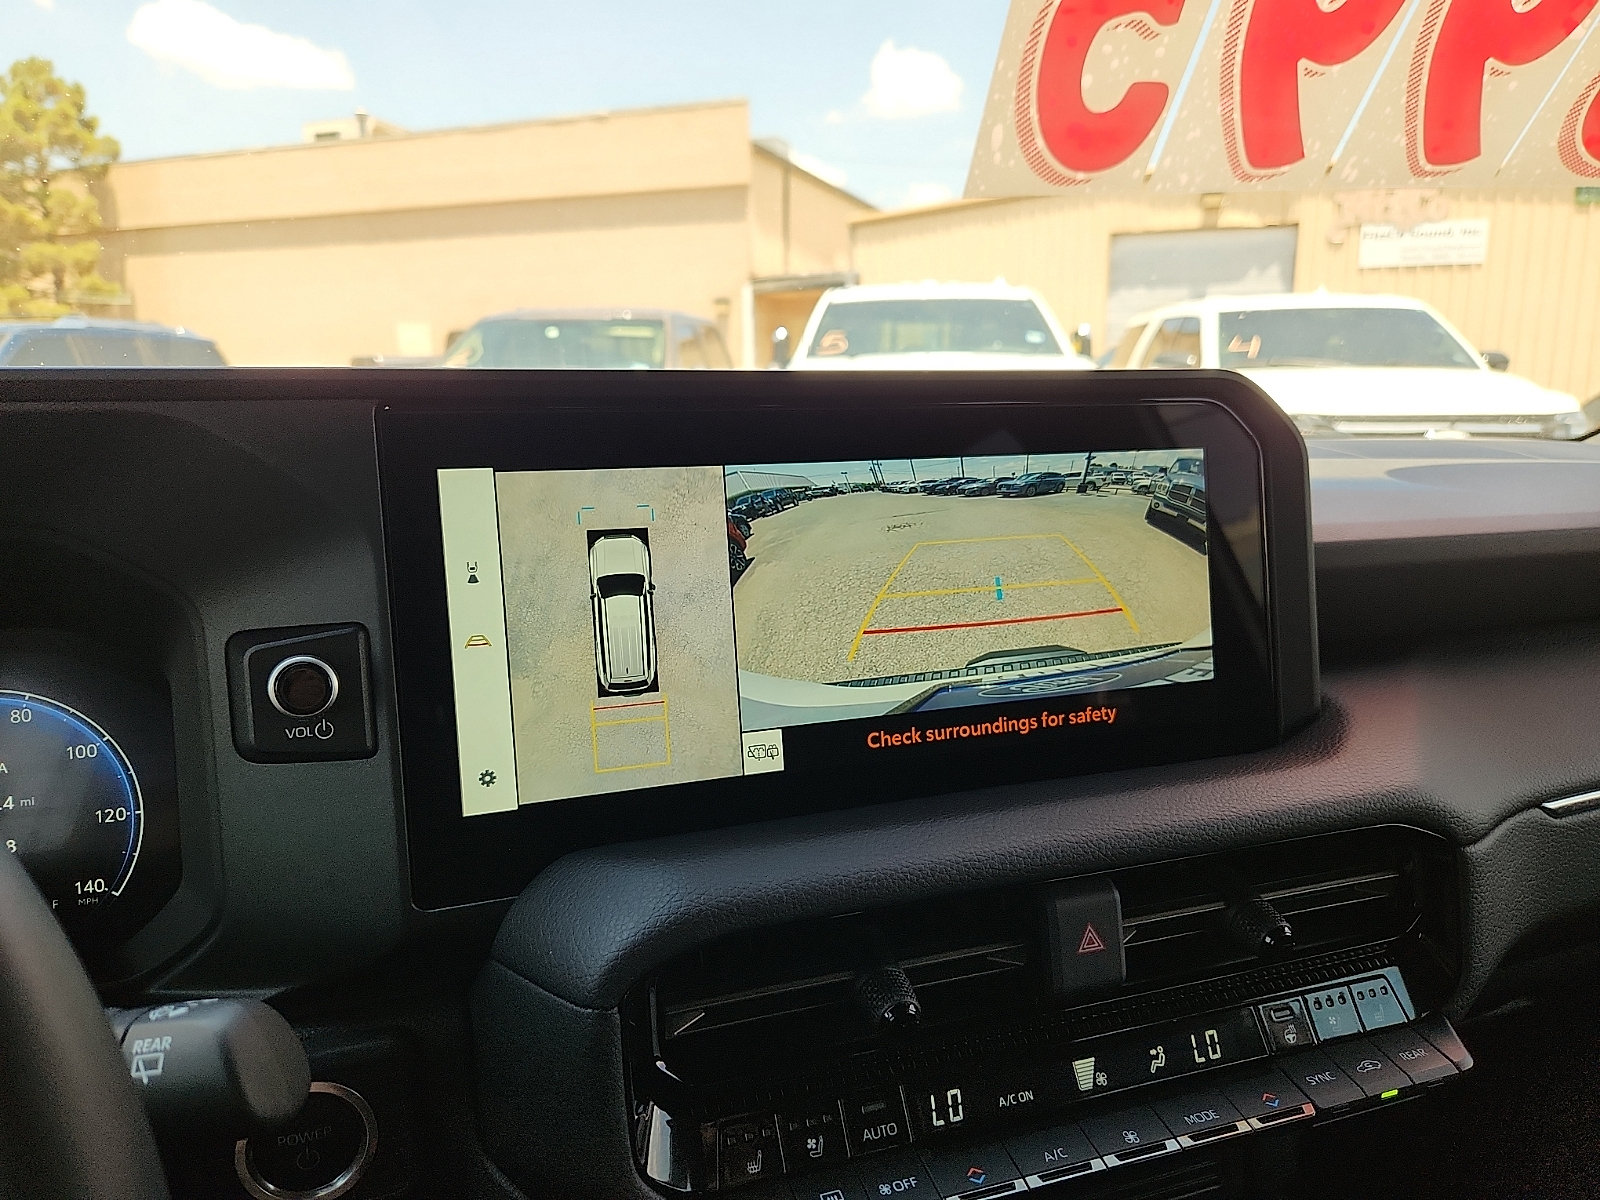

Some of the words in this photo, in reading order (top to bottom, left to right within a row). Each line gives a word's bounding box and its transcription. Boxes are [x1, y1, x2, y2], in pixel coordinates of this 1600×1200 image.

[1018, 0, 1600, 183] CPP
[1228, 334, 1261, 359] 4
[10, 708, 32, 724] 80
[285, 727, 313, 739] VOL
[867, 727, 922, 748] Check
[925, 717, 1038, 742] surroundings
[1041, 712, 1064, 727] for
[1068, 706, 1118, 724] safety
[66, 744, 98, 760] 100
[20, 797, 35, 807] mi
[95, 807, 127, 824] 120
[74, 878, 105, 895] 140
[78, 898, 99, 906] MPH
[132, 1035, 172, 1055] REAR
[1399, 1047, 1427, 1062] REAR
[1305, 1070, 1337, 1086] SYNC
[999, 1094, 1018, 1107] A/C
[1018, 1090, 1034, 1103] ON
[1184, 1109, 1220, 1126] MODE
[277, 1125, 333, 1148] POWER
[862, 1122, 898, 1142] AUTO
[1044, 1147, 1068, 1162] A/C
[892, 1176, 918, 1192] OFF
